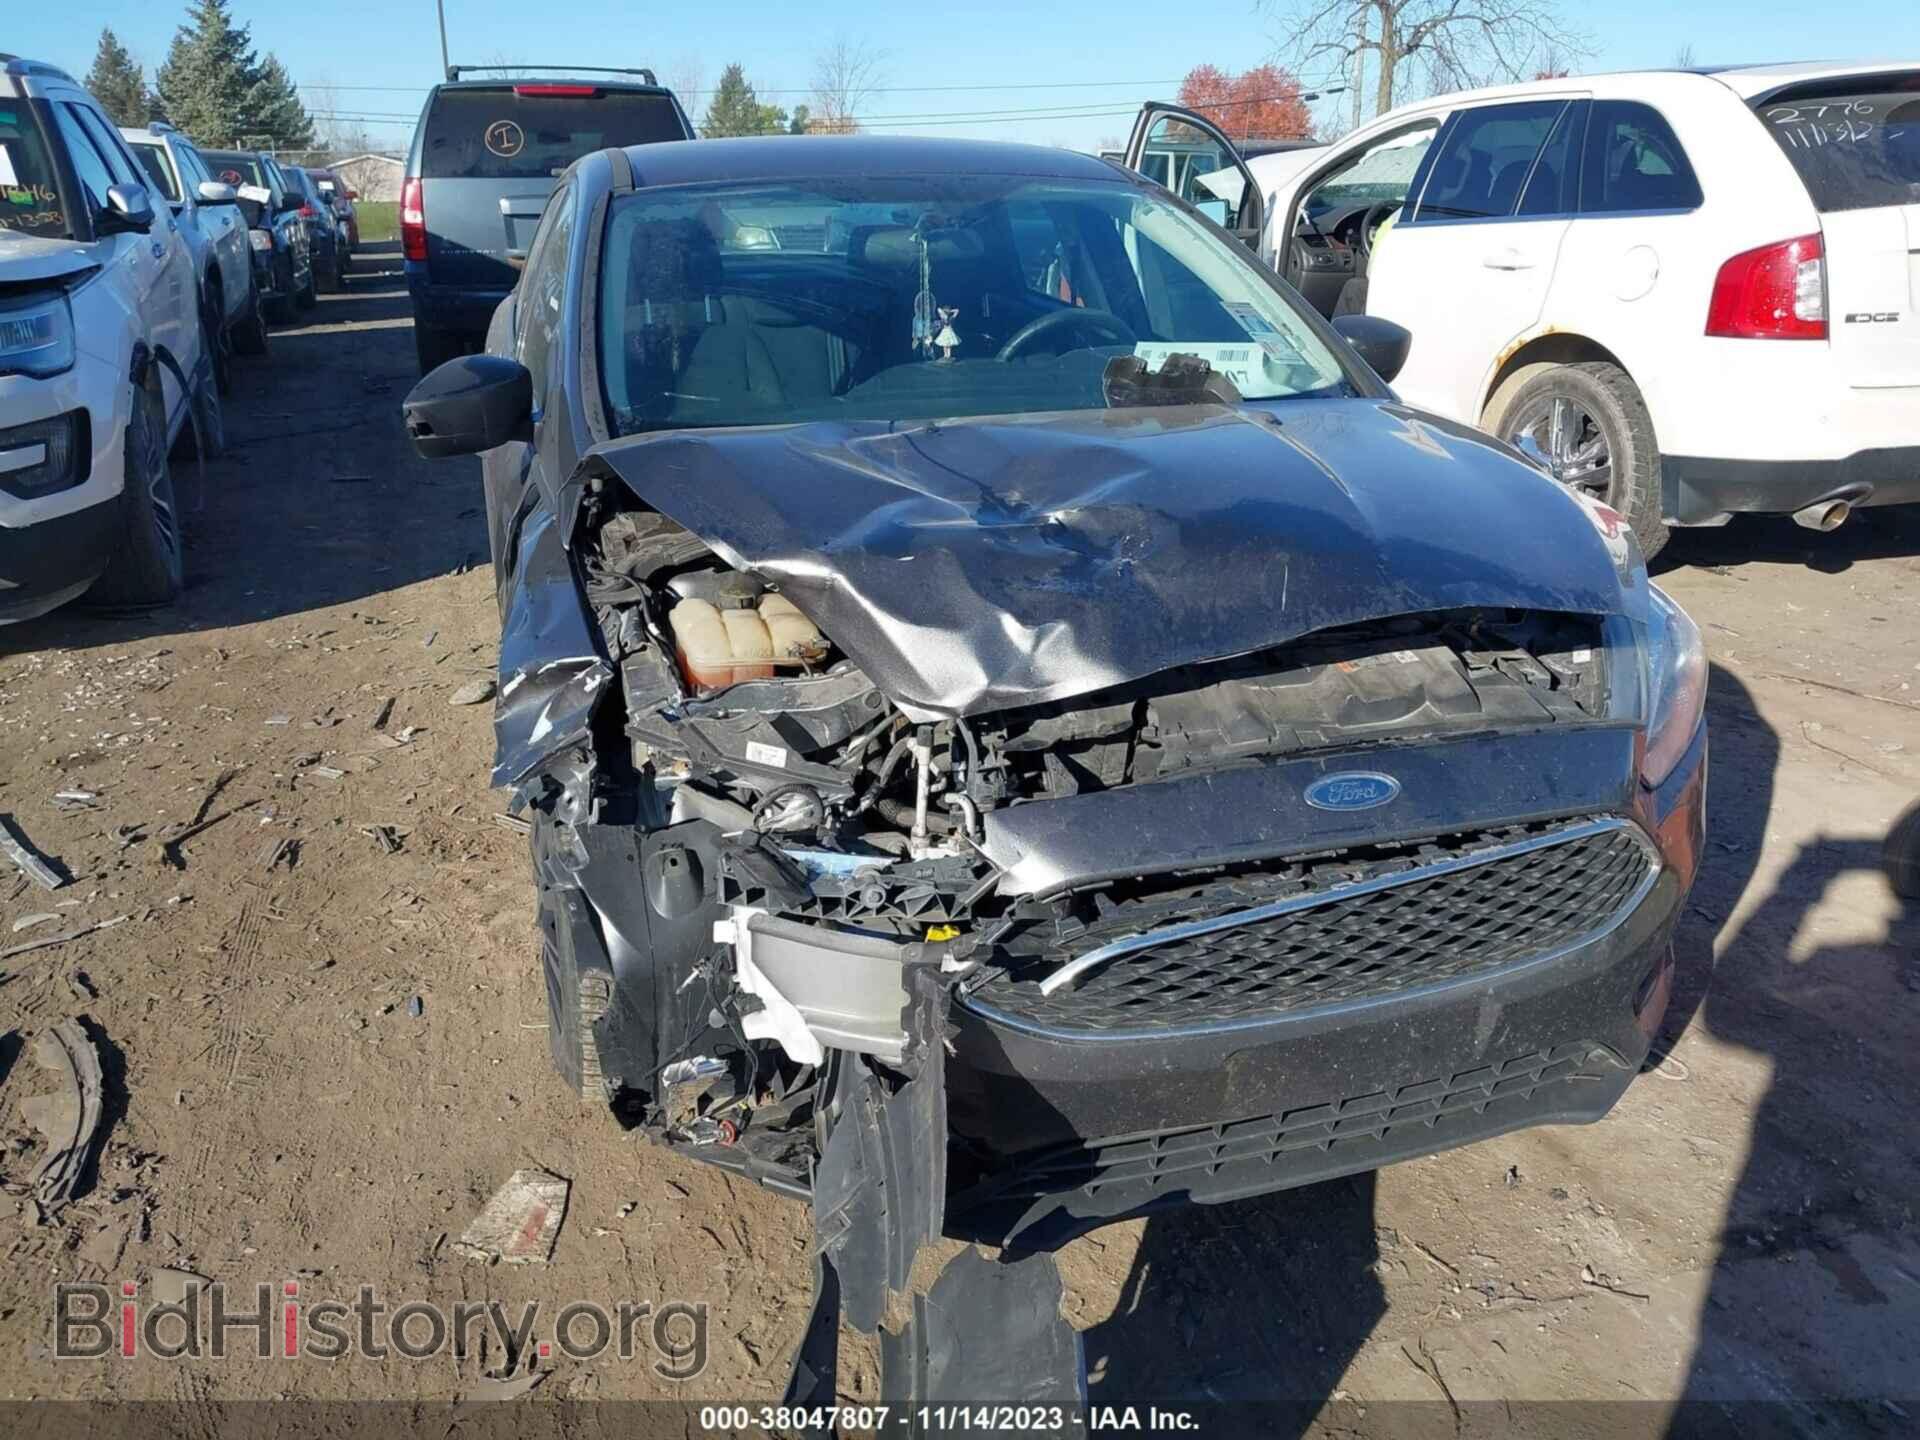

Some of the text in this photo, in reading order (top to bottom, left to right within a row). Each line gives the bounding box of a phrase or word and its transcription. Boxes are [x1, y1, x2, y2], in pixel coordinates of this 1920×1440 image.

[1766, 100, 1874, 124] 2776
[1845, 312, 1899, 323] EDGE
[1328, 782, 1377, 803] Ford
